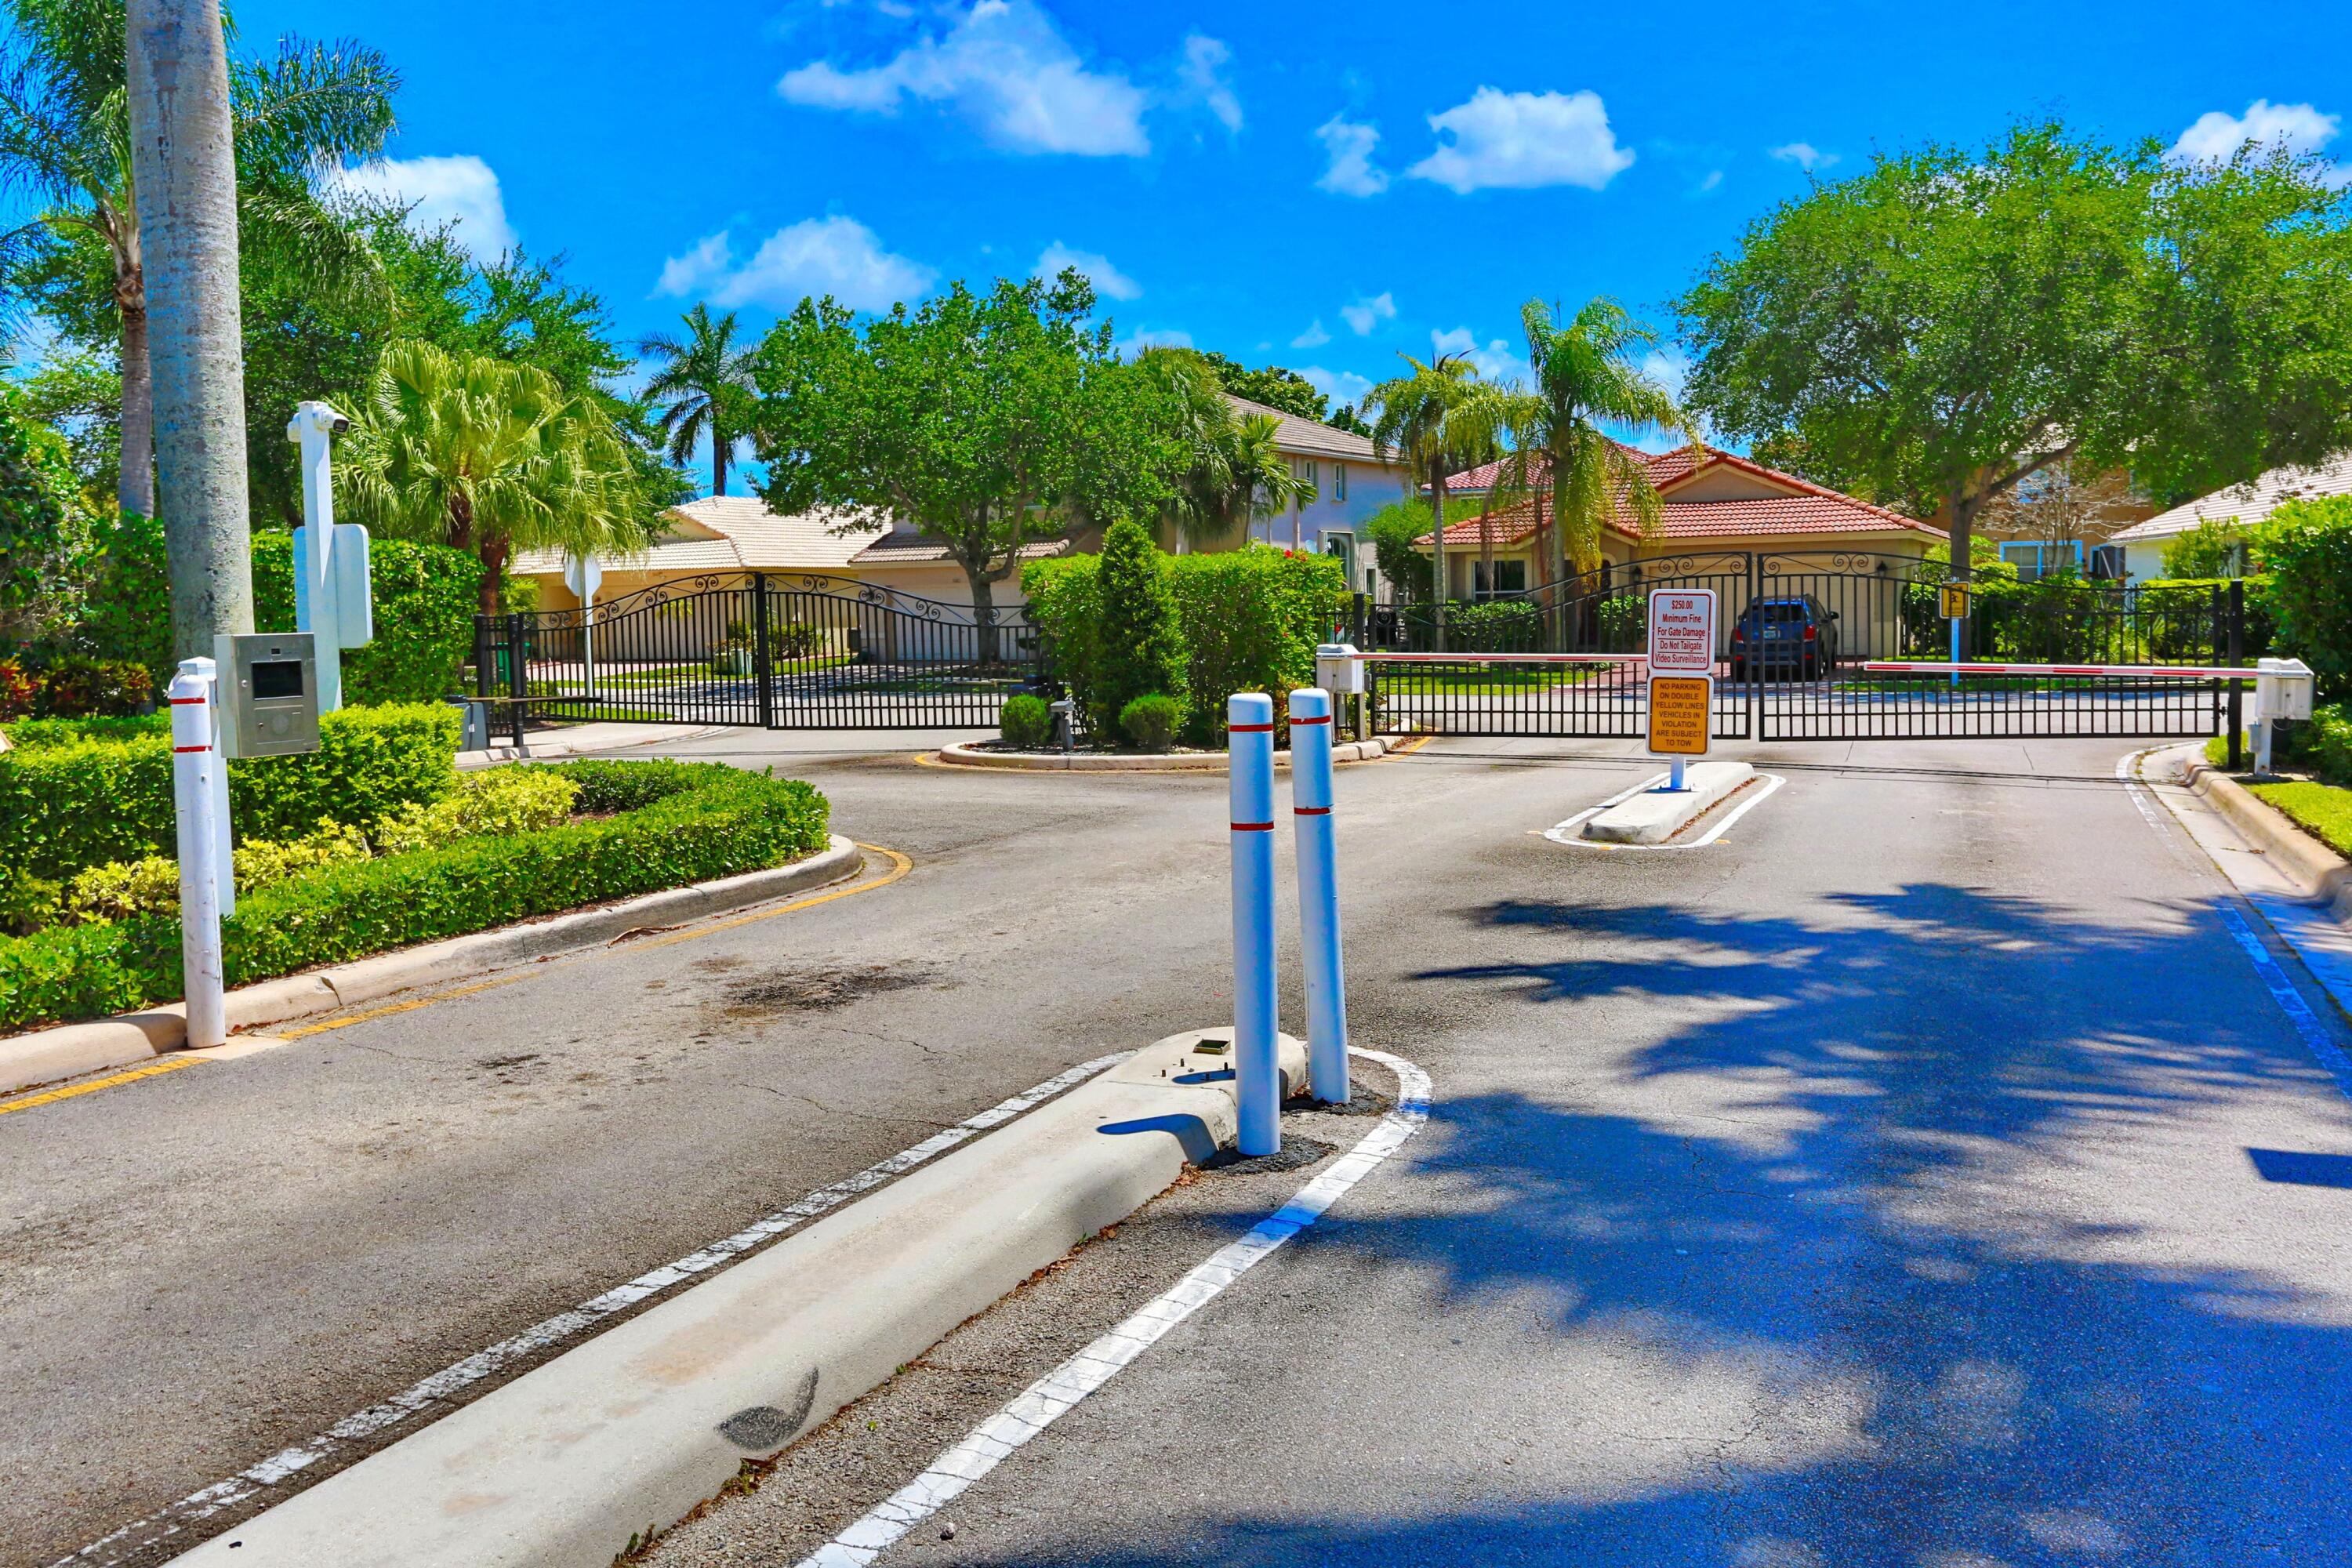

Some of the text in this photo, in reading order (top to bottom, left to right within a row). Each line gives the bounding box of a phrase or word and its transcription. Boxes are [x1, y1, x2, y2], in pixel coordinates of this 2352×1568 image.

[1671, 600, 1693, 609] $250.00
[1662, 614, 1701, 622] Minimum Fine
[1657, 627, 1705, 638] For Gate Damage
[1660, 641, 1702, 652] Do Not Tailgate
[1655, 653, 1706, 663] Video Surveillance
